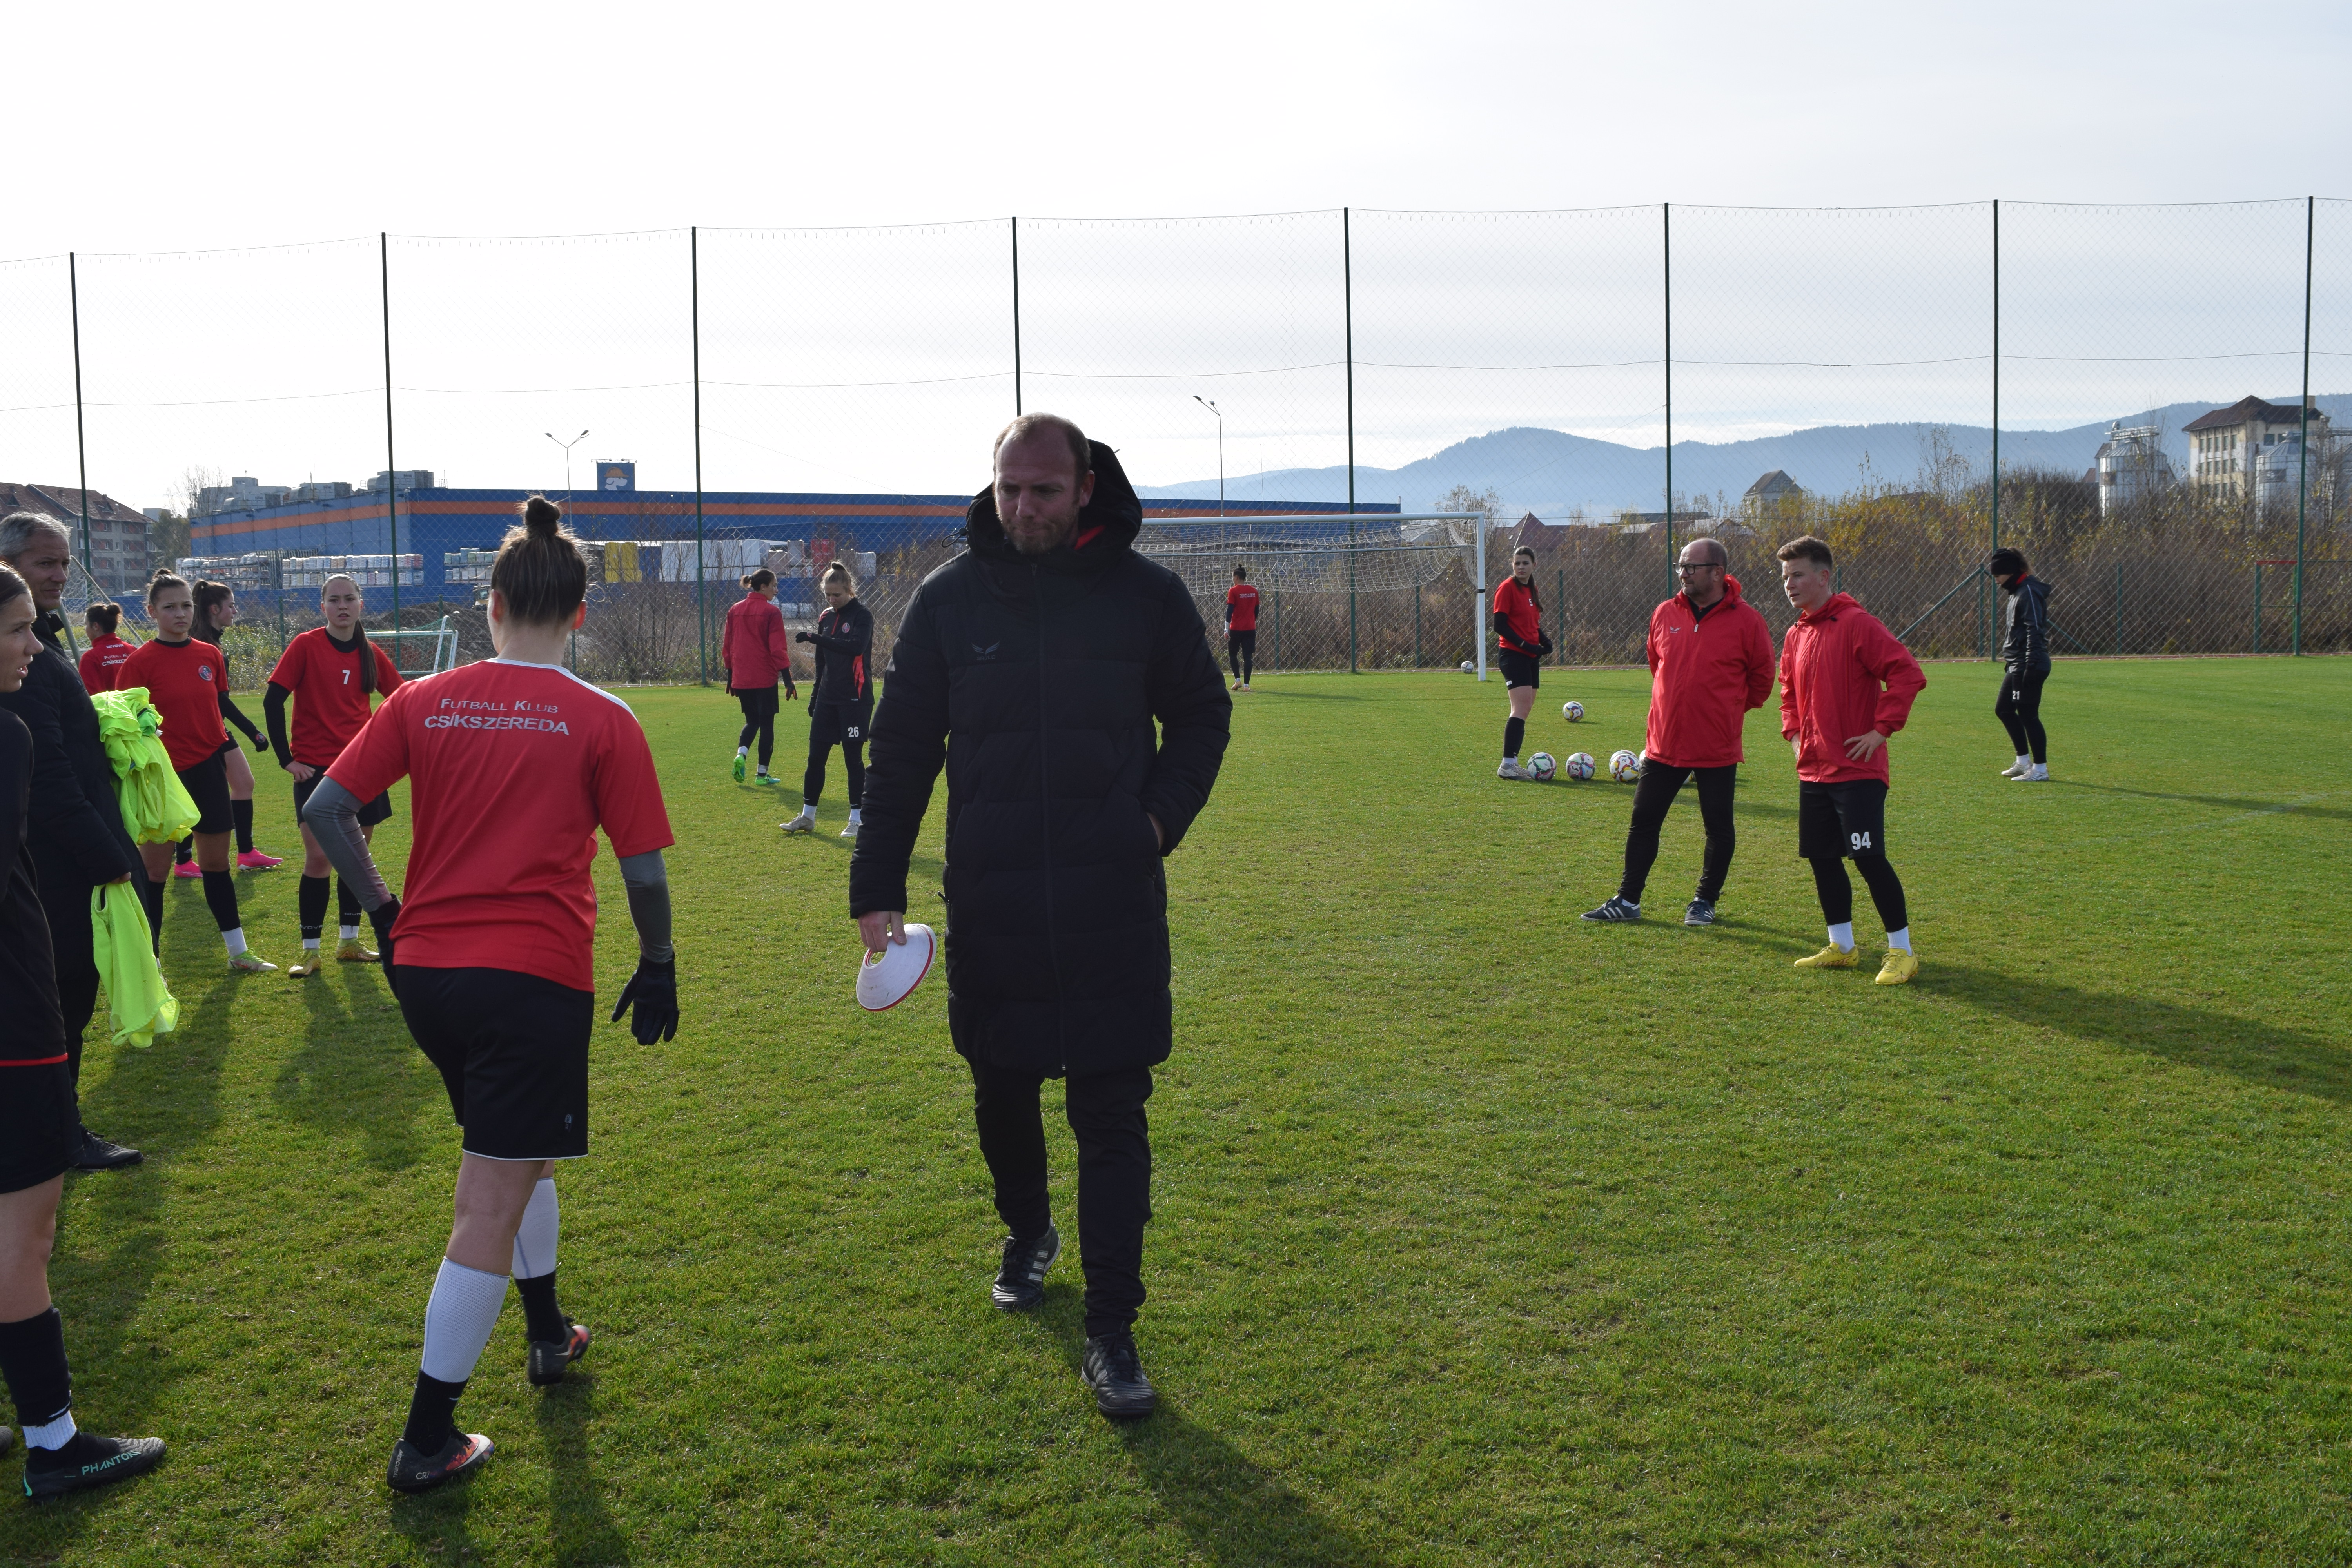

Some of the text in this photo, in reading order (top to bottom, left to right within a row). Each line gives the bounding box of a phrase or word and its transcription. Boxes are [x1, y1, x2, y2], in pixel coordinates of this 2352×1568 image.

[342, 670, 350, 684] 7
[2013, 690, 2020, 700] 21
[441, 698, 558, 713] FUTBALL KLUB
[425, 712, 570, 735] CSÍKSZEREDA
[848, 726, 859, 737] 26
[1851, 831, 1871, 850] 94
[82, 1450, 142, 1475] PHANTOM
[416, 1471, 430, 1480] CR7
